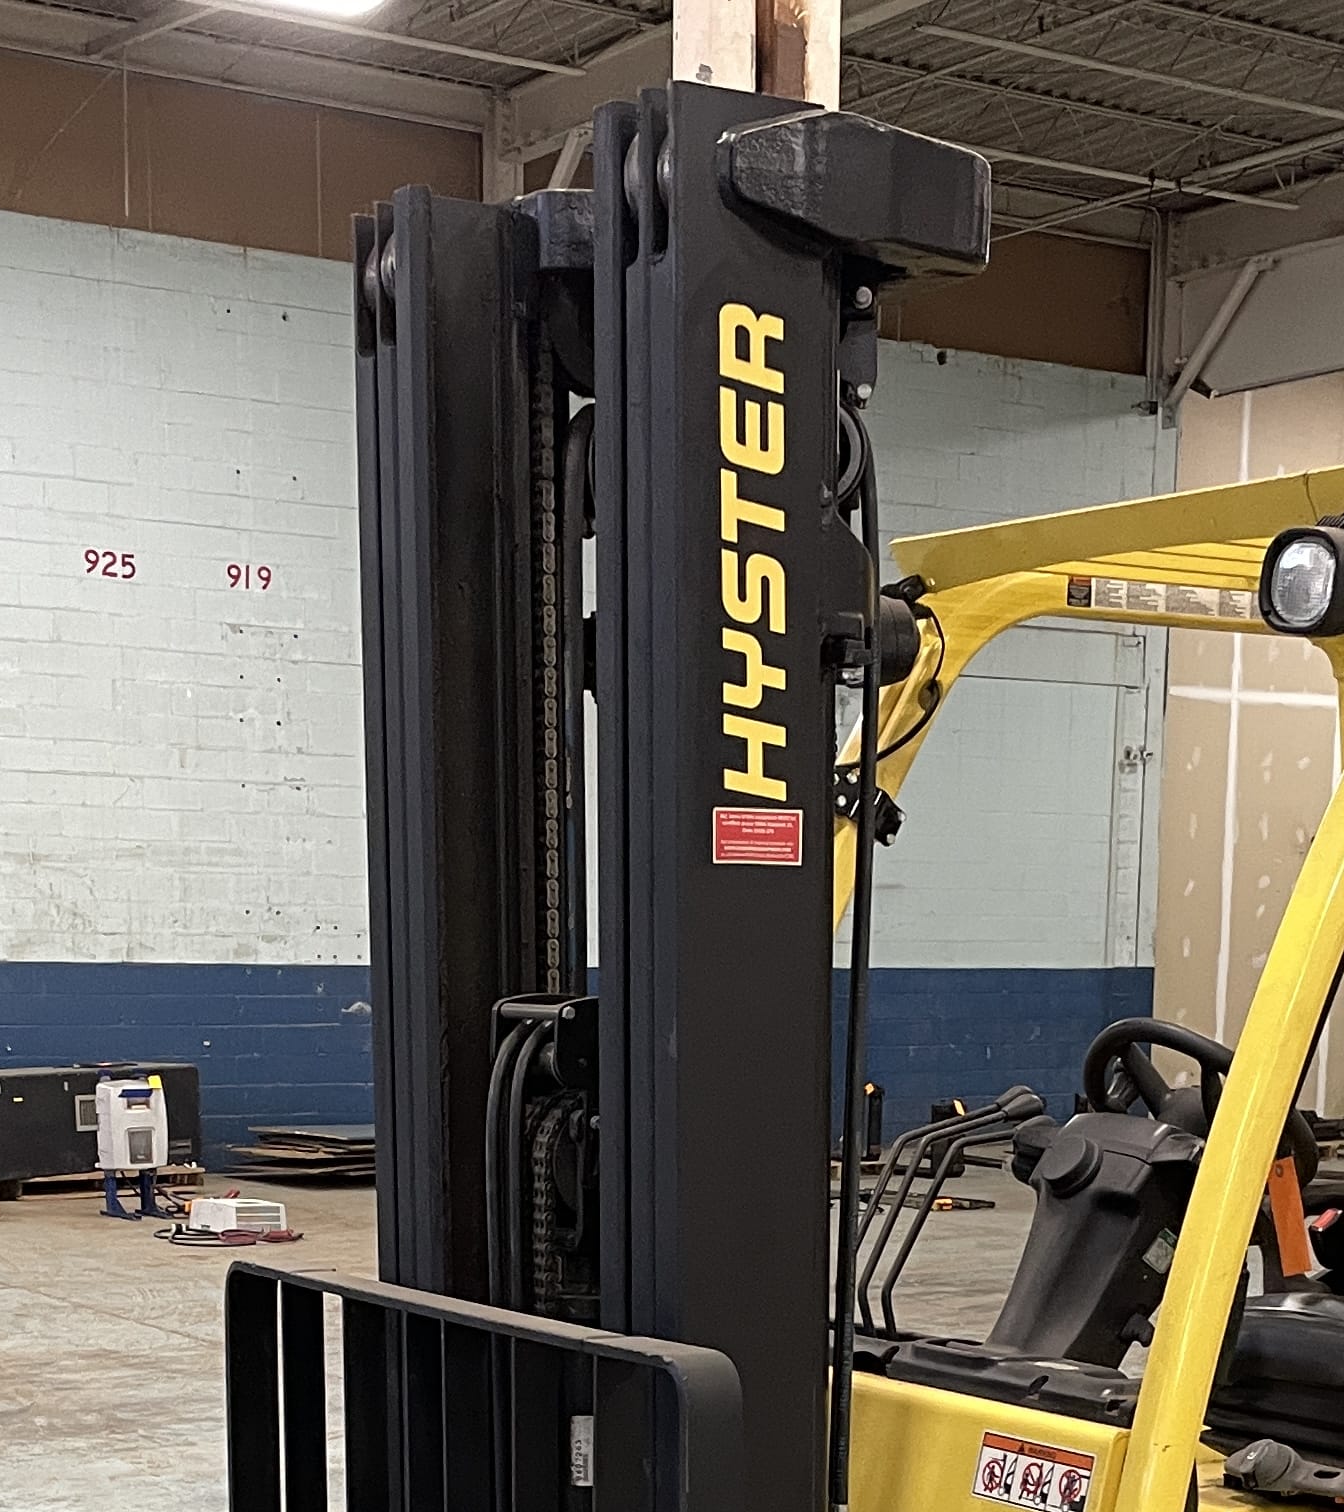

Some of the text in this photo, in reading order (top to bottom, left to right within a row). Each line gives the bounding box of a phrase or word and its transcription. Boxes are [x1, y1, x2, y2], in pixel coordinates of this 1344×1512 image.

[84, 549, 137, 580] 925
[719, 301, 786, 801] HYSTER
[226, 564, 273, 591] 919
